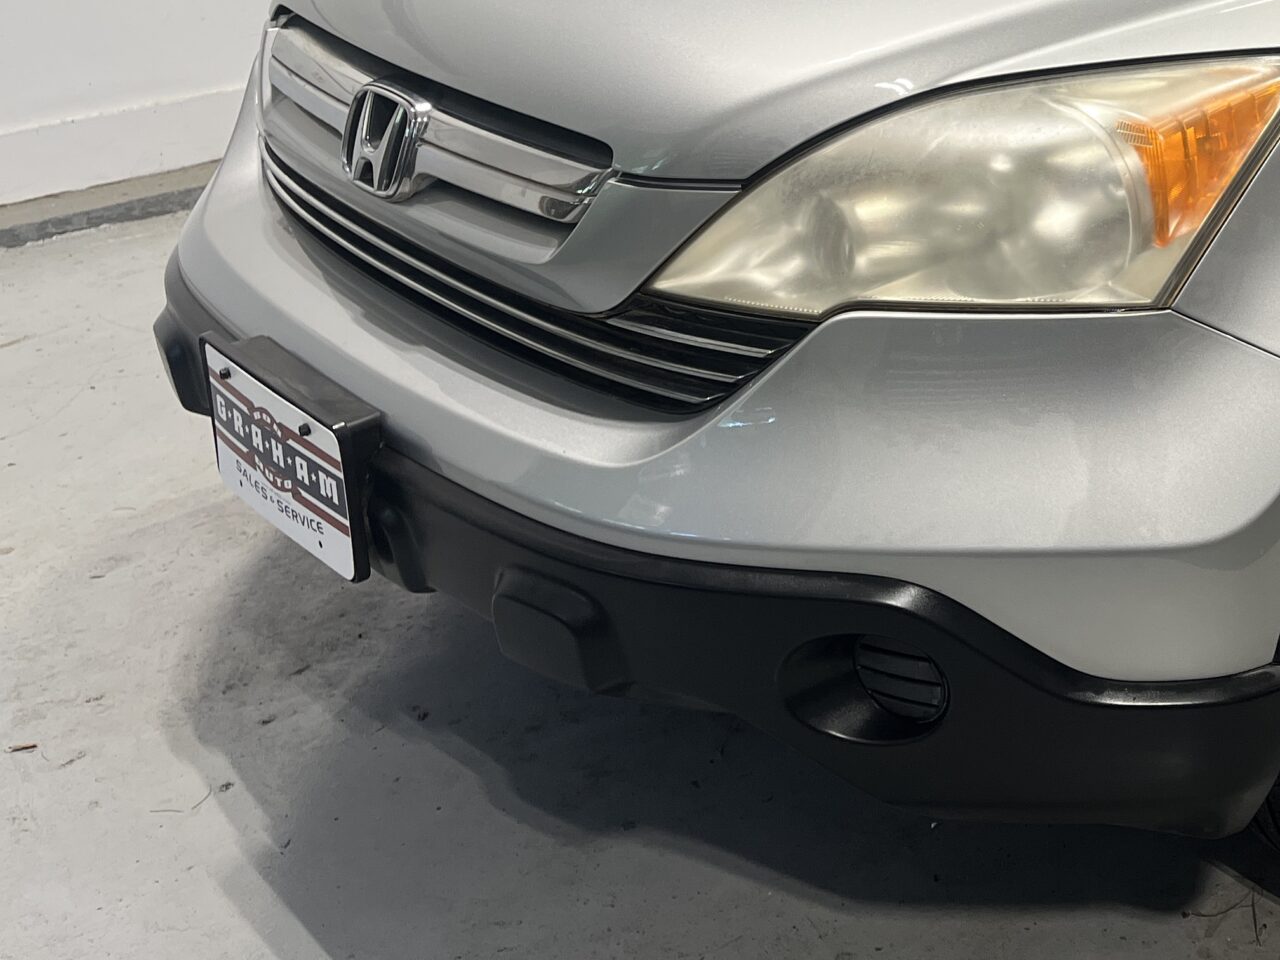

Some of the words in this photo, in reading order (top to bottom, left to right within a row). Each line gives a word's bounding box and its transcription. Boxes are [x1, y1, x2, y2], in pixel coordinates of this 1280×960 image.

[235, 459, 268, 500] SALES
[276, 501, 324, 536] SERVICE
[254, 454, 292, 490] AUTO
